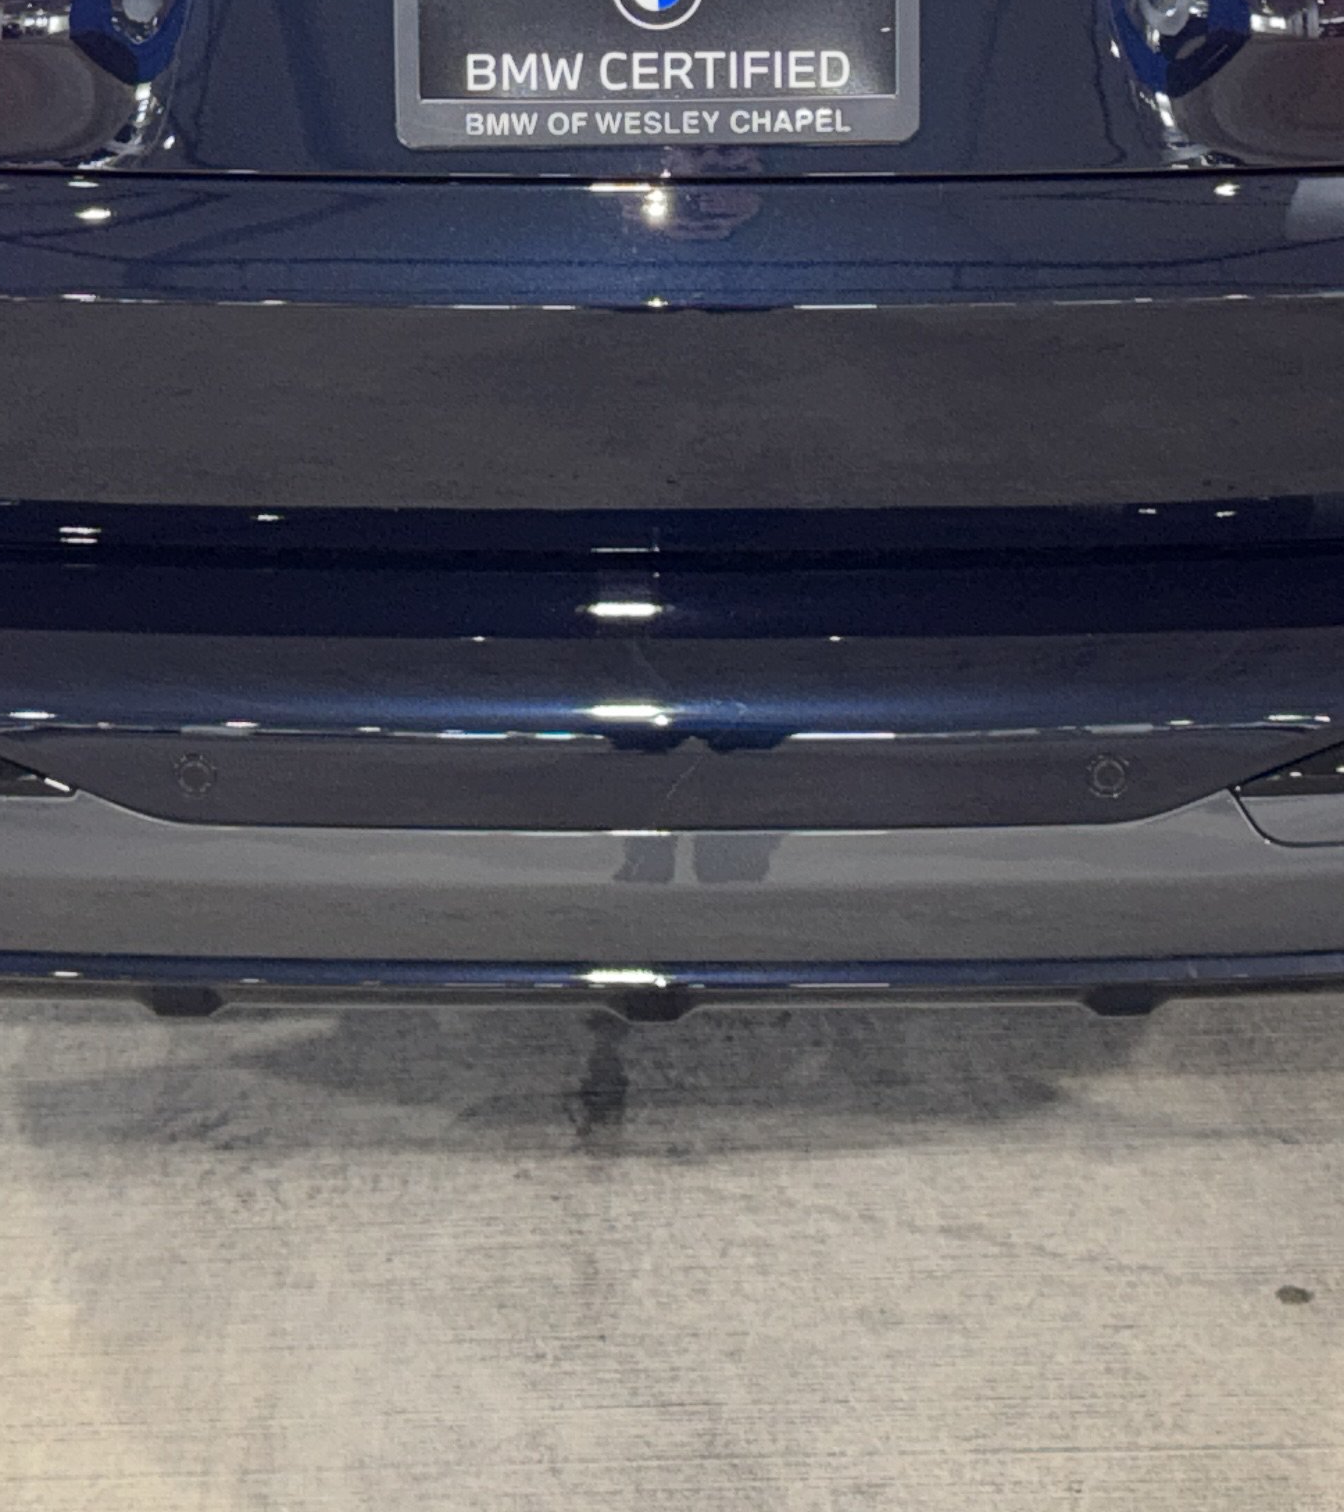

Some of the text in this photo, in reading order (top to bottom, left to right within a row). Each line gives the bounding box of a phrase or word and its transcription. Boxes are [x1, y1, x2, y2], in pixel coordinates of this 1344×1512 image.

[466, 50, 851, 91] BMW CERTIFIED
[466, 108, 852, 136] BMW OF WESLEY CHAPEL
